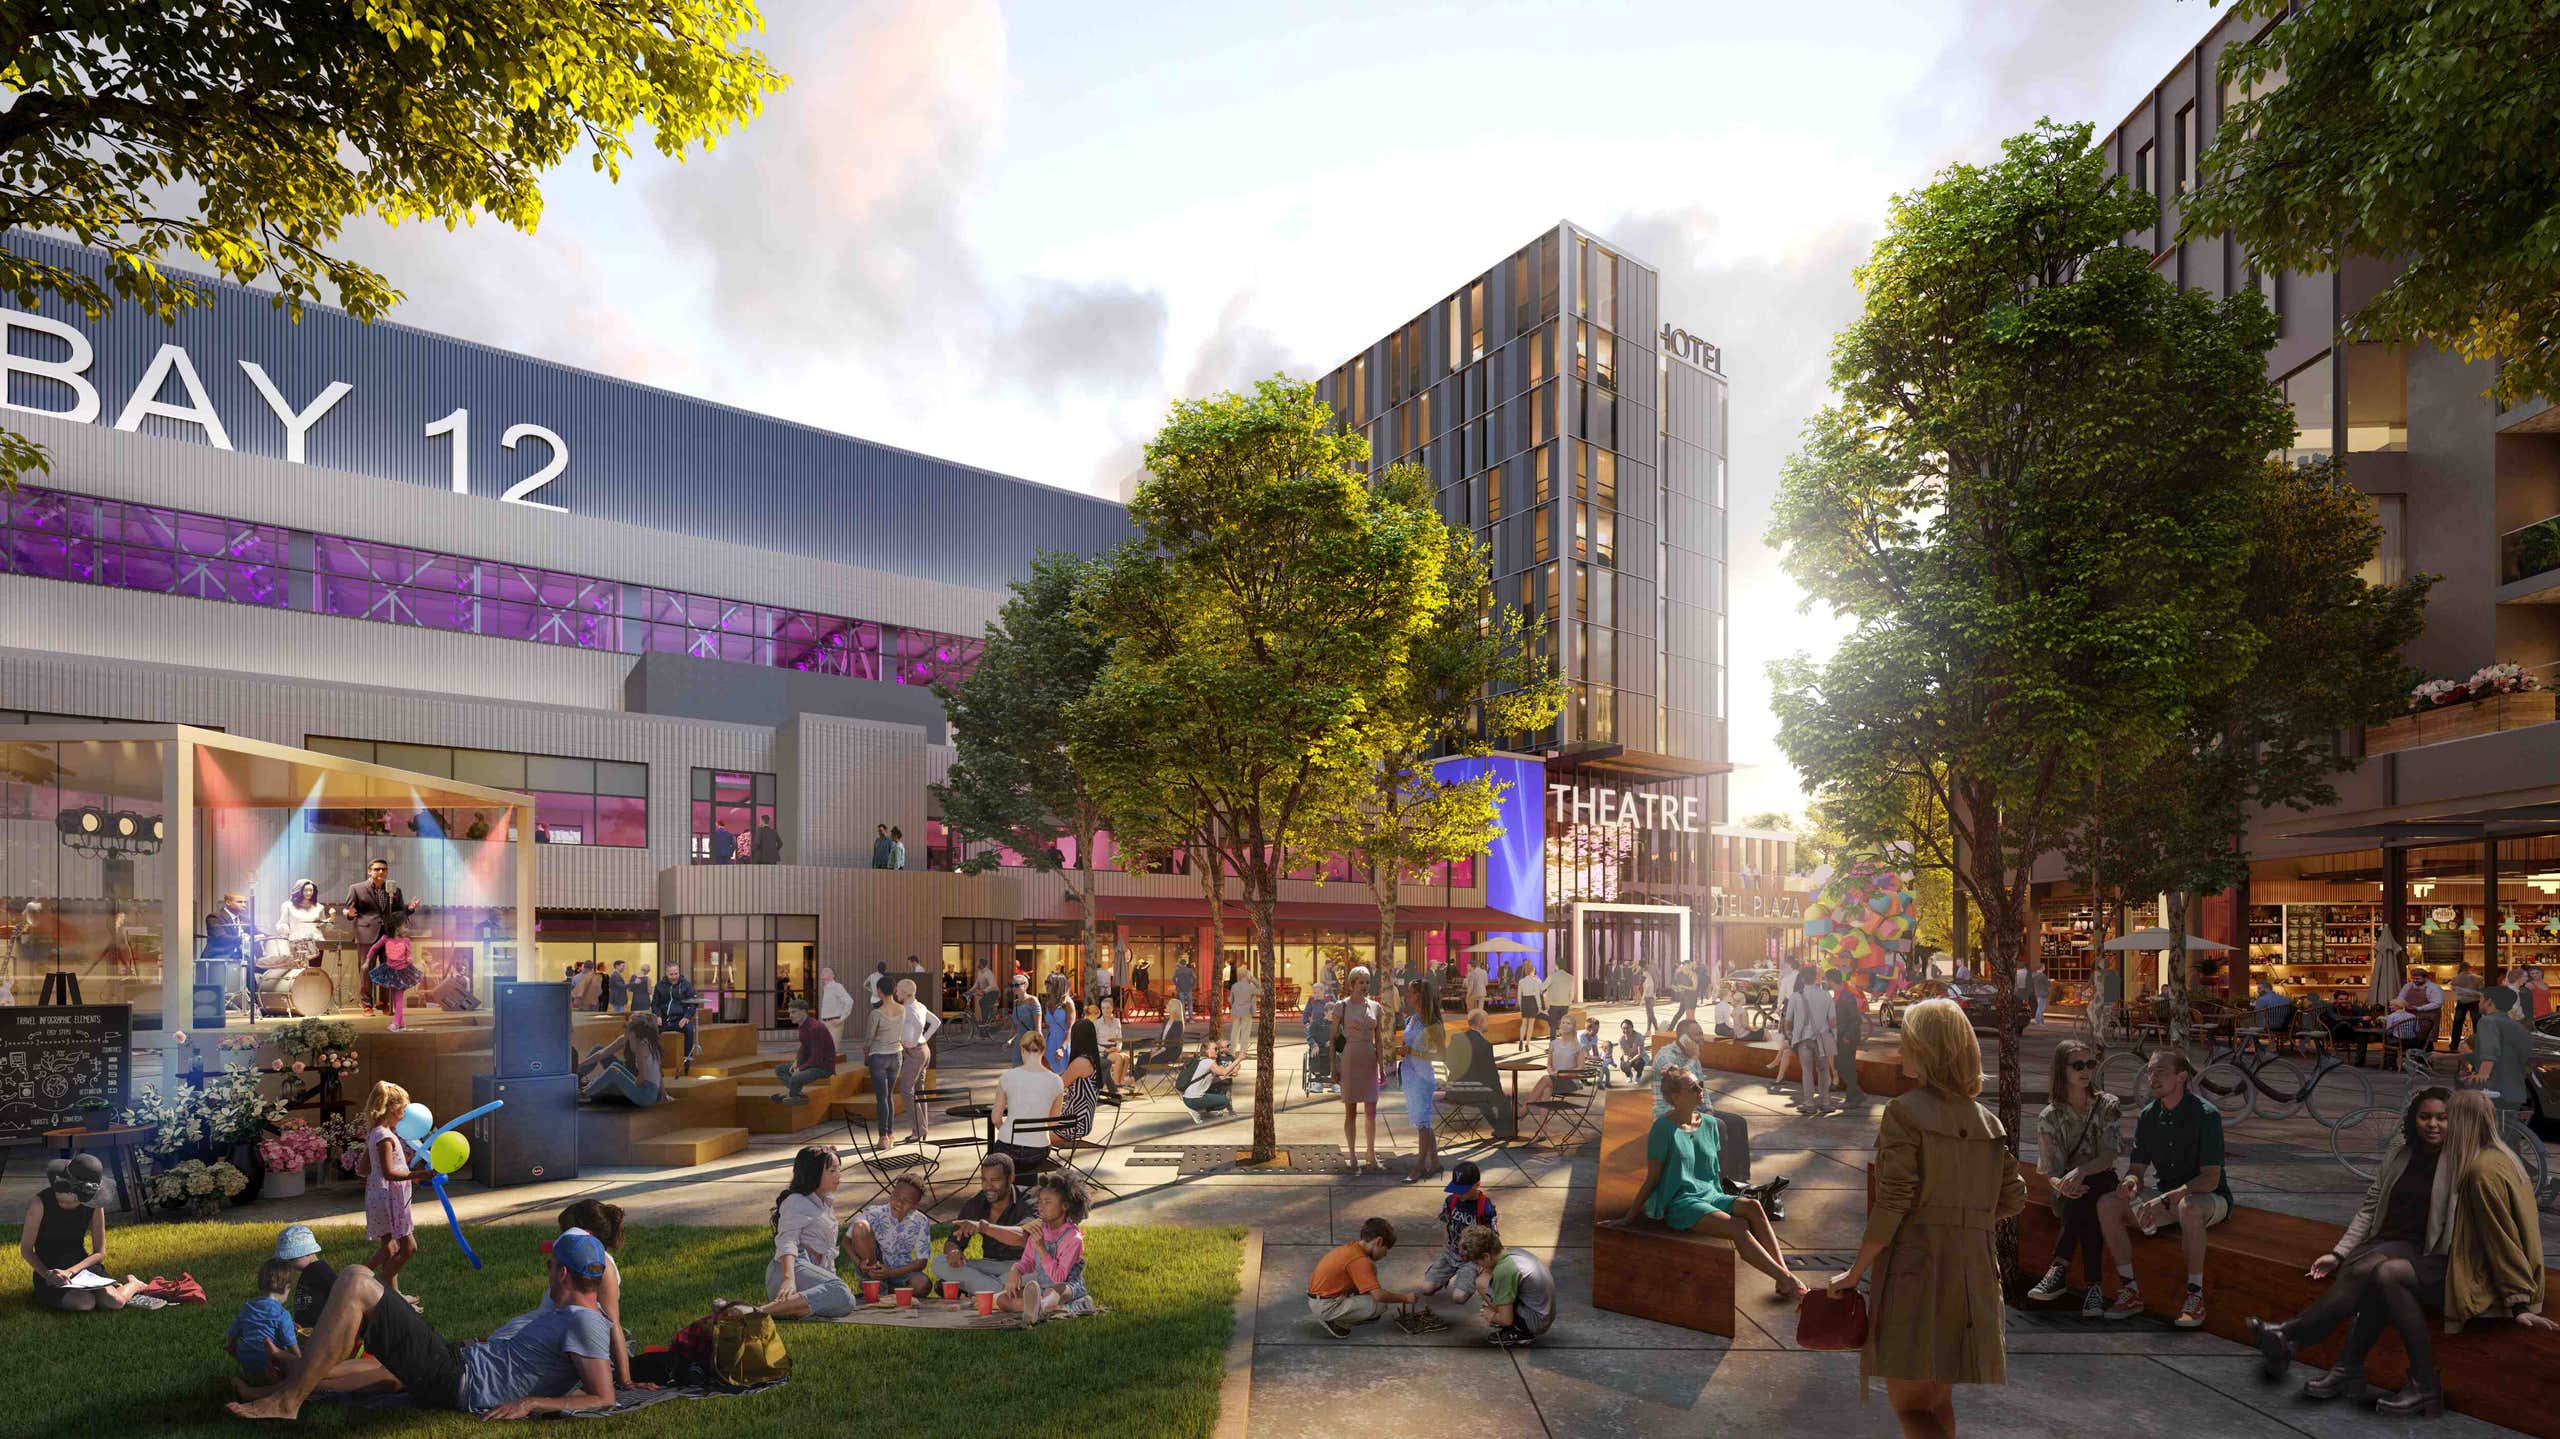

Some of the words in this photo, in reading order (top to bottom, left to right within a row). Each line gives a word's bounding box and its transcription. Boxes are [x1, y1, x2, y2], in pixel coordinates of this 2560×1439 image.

[1660, 322, 1728, 378] HOTEL
[0, 309, 354, 465] BAY
[425, 407, 570, 514] 12
[1549, 783, 1700, 833] THEATRE
[1711, 894, 1746, 918] OTEL
[1753, 895, 1801, 920] PLAZA
[16, 1016, 36, 1025] TRAVEL
[39, 1015, 72, 1025] INFOGRAPHIC
[74, 1014, 101, 1025] ELEMENTS
